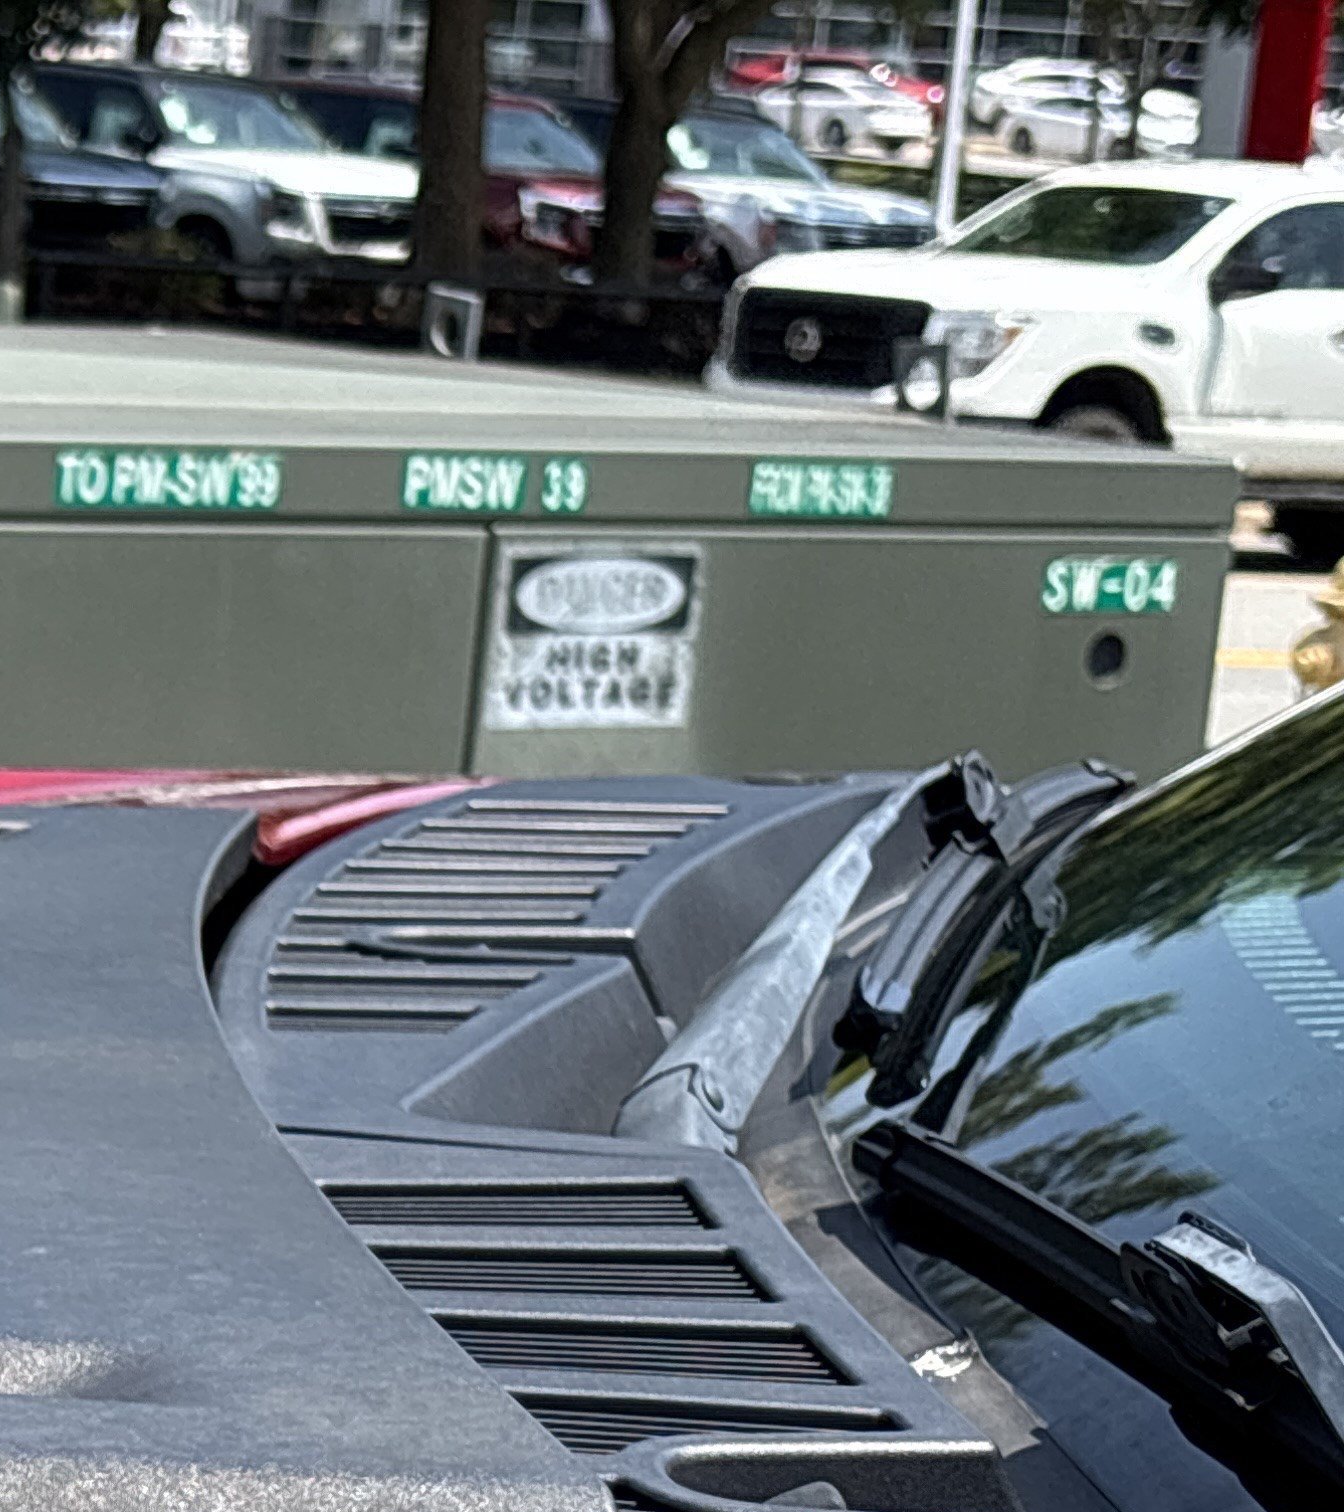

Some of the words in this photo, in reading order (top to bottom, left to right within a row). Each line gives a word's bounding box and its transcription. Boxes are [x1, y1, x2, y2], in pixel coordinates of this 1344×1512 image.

[57, 452, 108, 504] TO
[404, 455, 526, 509] PMSW
[1041, 558, 1178, 612] SW-04
[544, 641, 642, 673] HIGH
[505, 675, 676, 710] VOLTAGE
